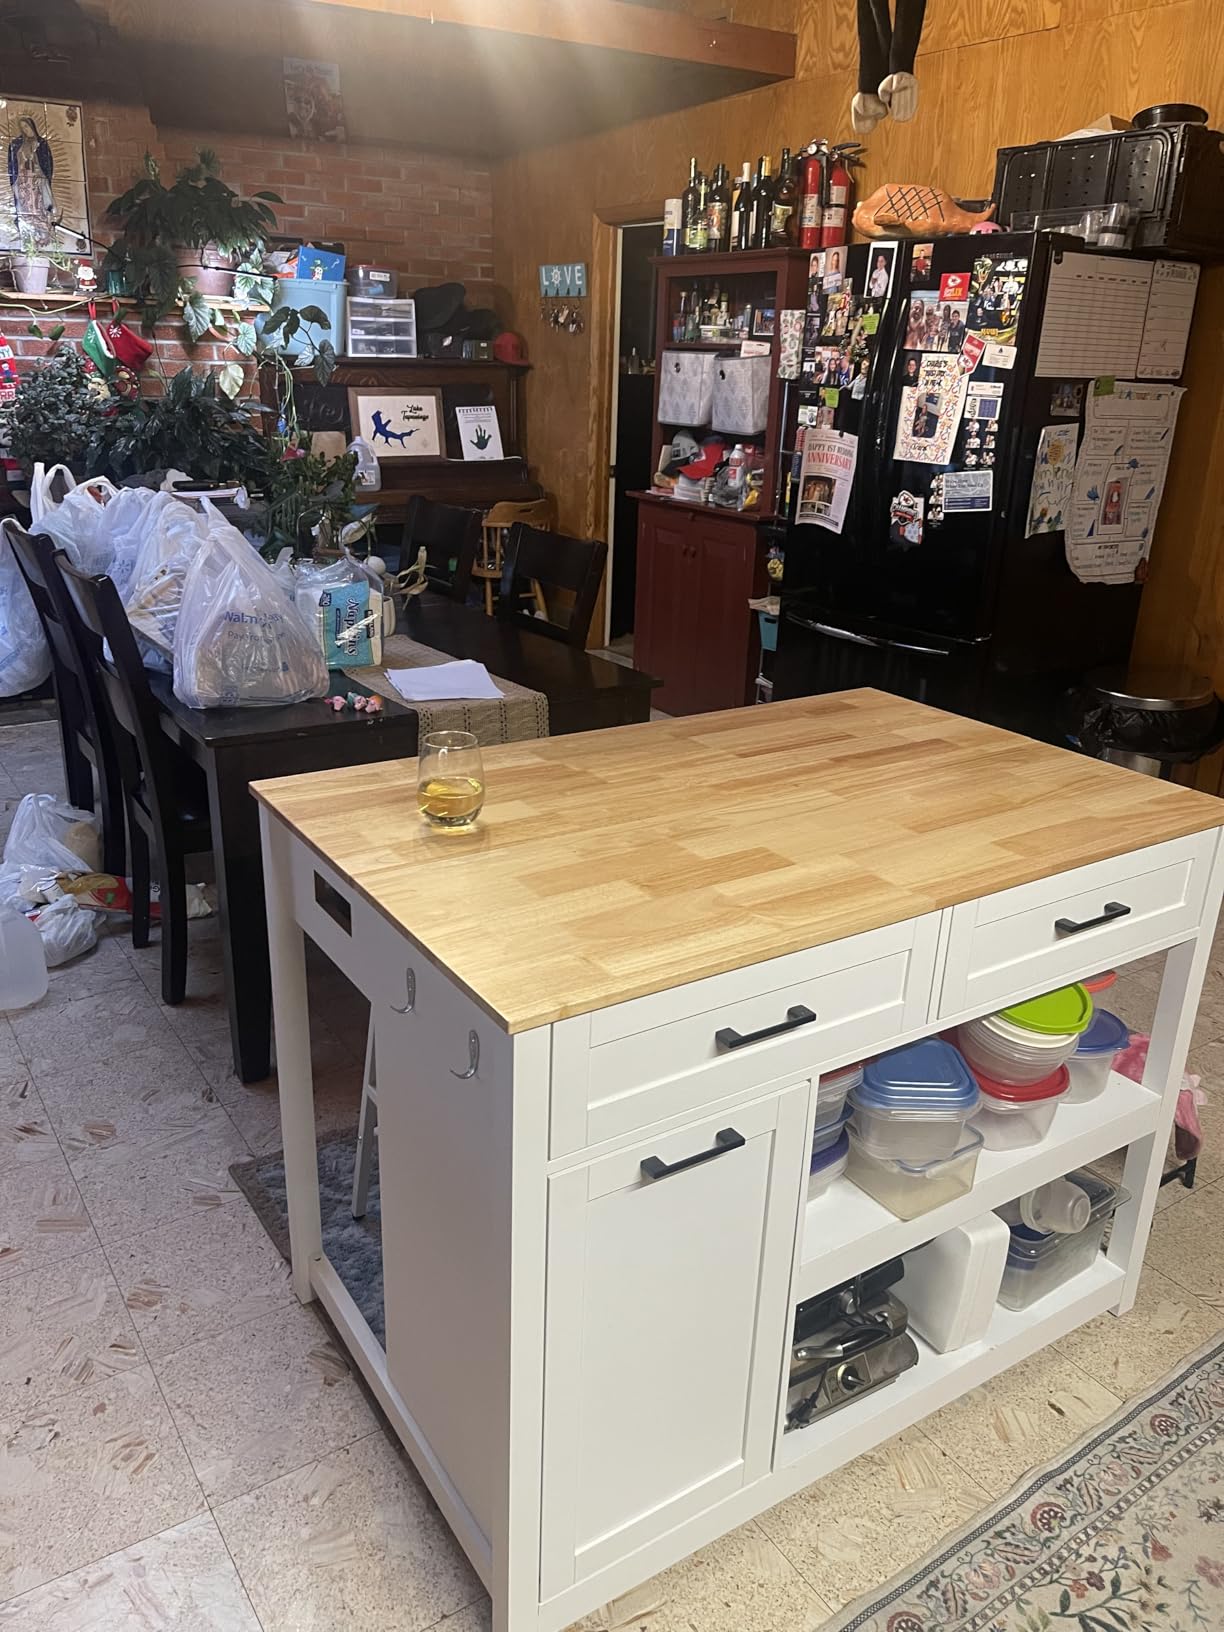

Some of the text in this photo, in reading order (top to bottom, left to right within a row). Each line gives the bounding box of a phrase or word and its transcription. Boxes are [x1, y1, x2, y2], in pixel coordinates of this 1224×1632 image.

[542, 265, 583, 287] LOVE
[808, 451, 853, 471] ANNIVERSARY
[344, 597, 360, 656] Napins
